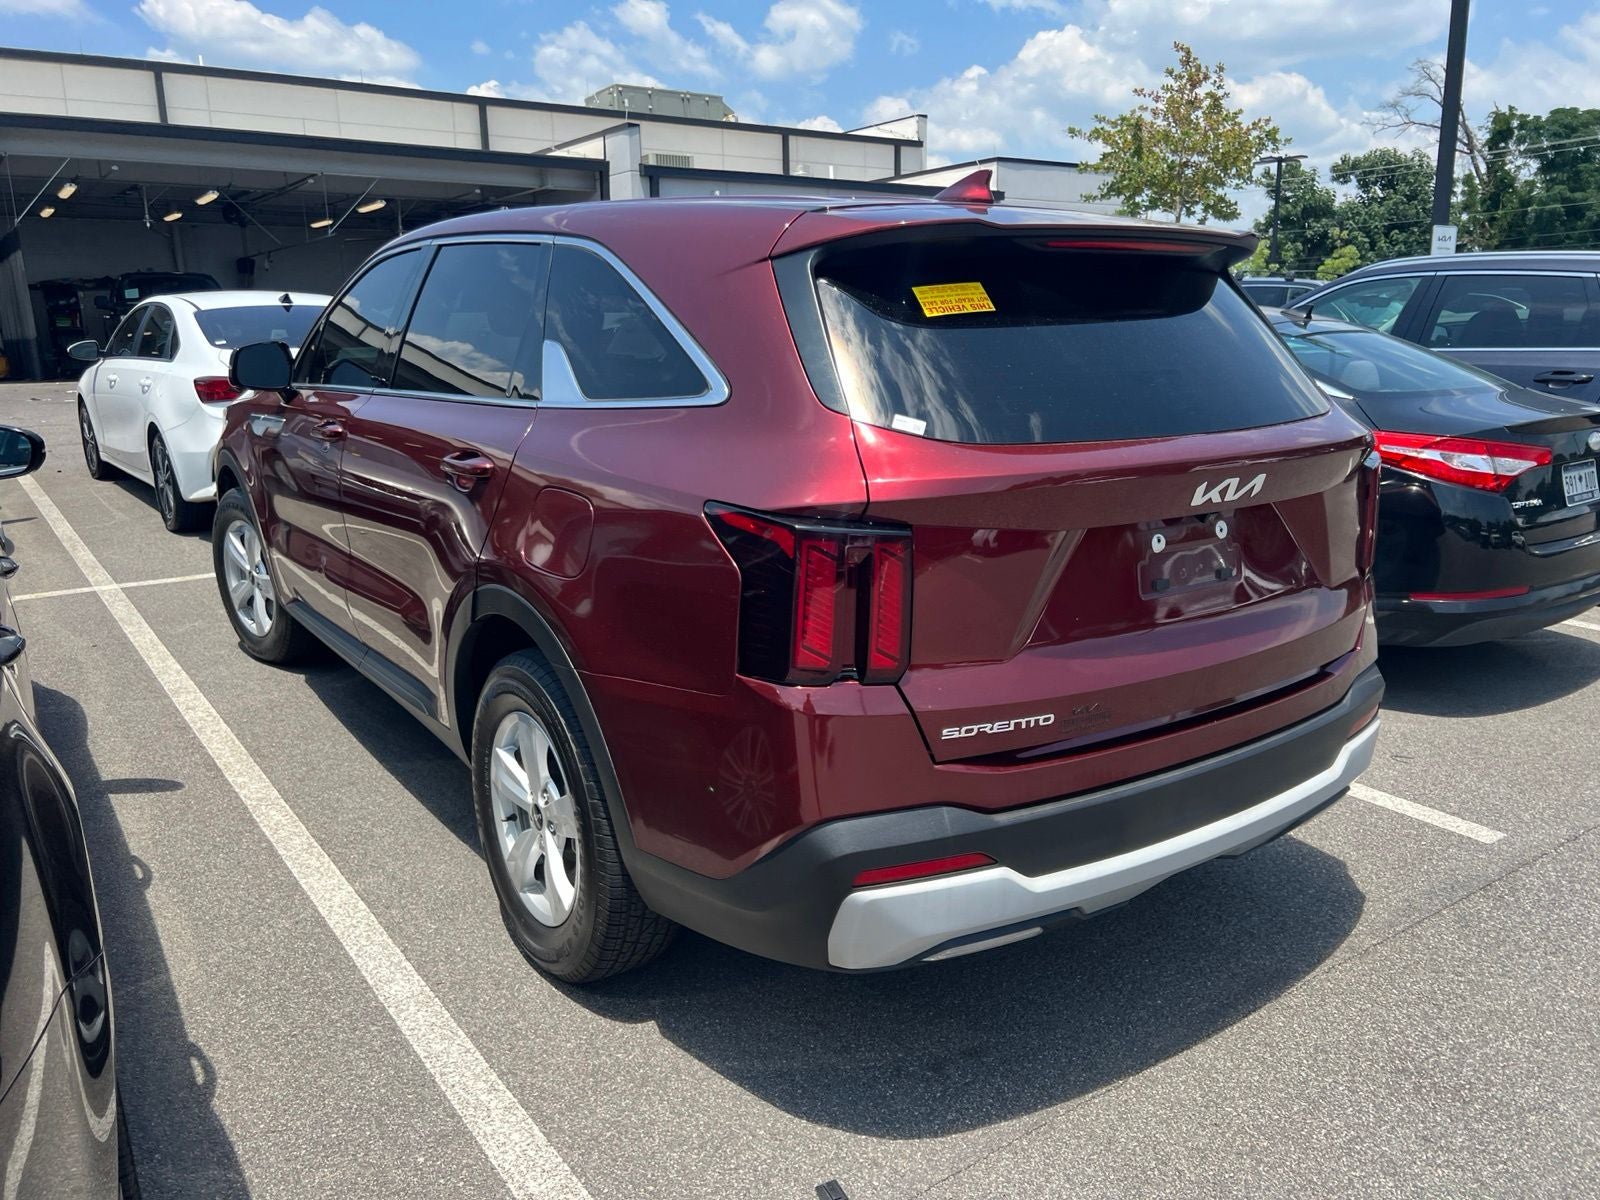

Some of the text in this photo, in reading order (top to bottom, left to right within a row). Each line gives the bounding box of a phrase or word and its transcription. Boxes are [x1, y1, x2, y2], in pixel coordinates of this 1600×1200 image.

[926, 302, 993, 315] THIS VEHICLE
[1190, 473, 1267, 507] KIA
[941, 713, 1055, 740] SORENTO
